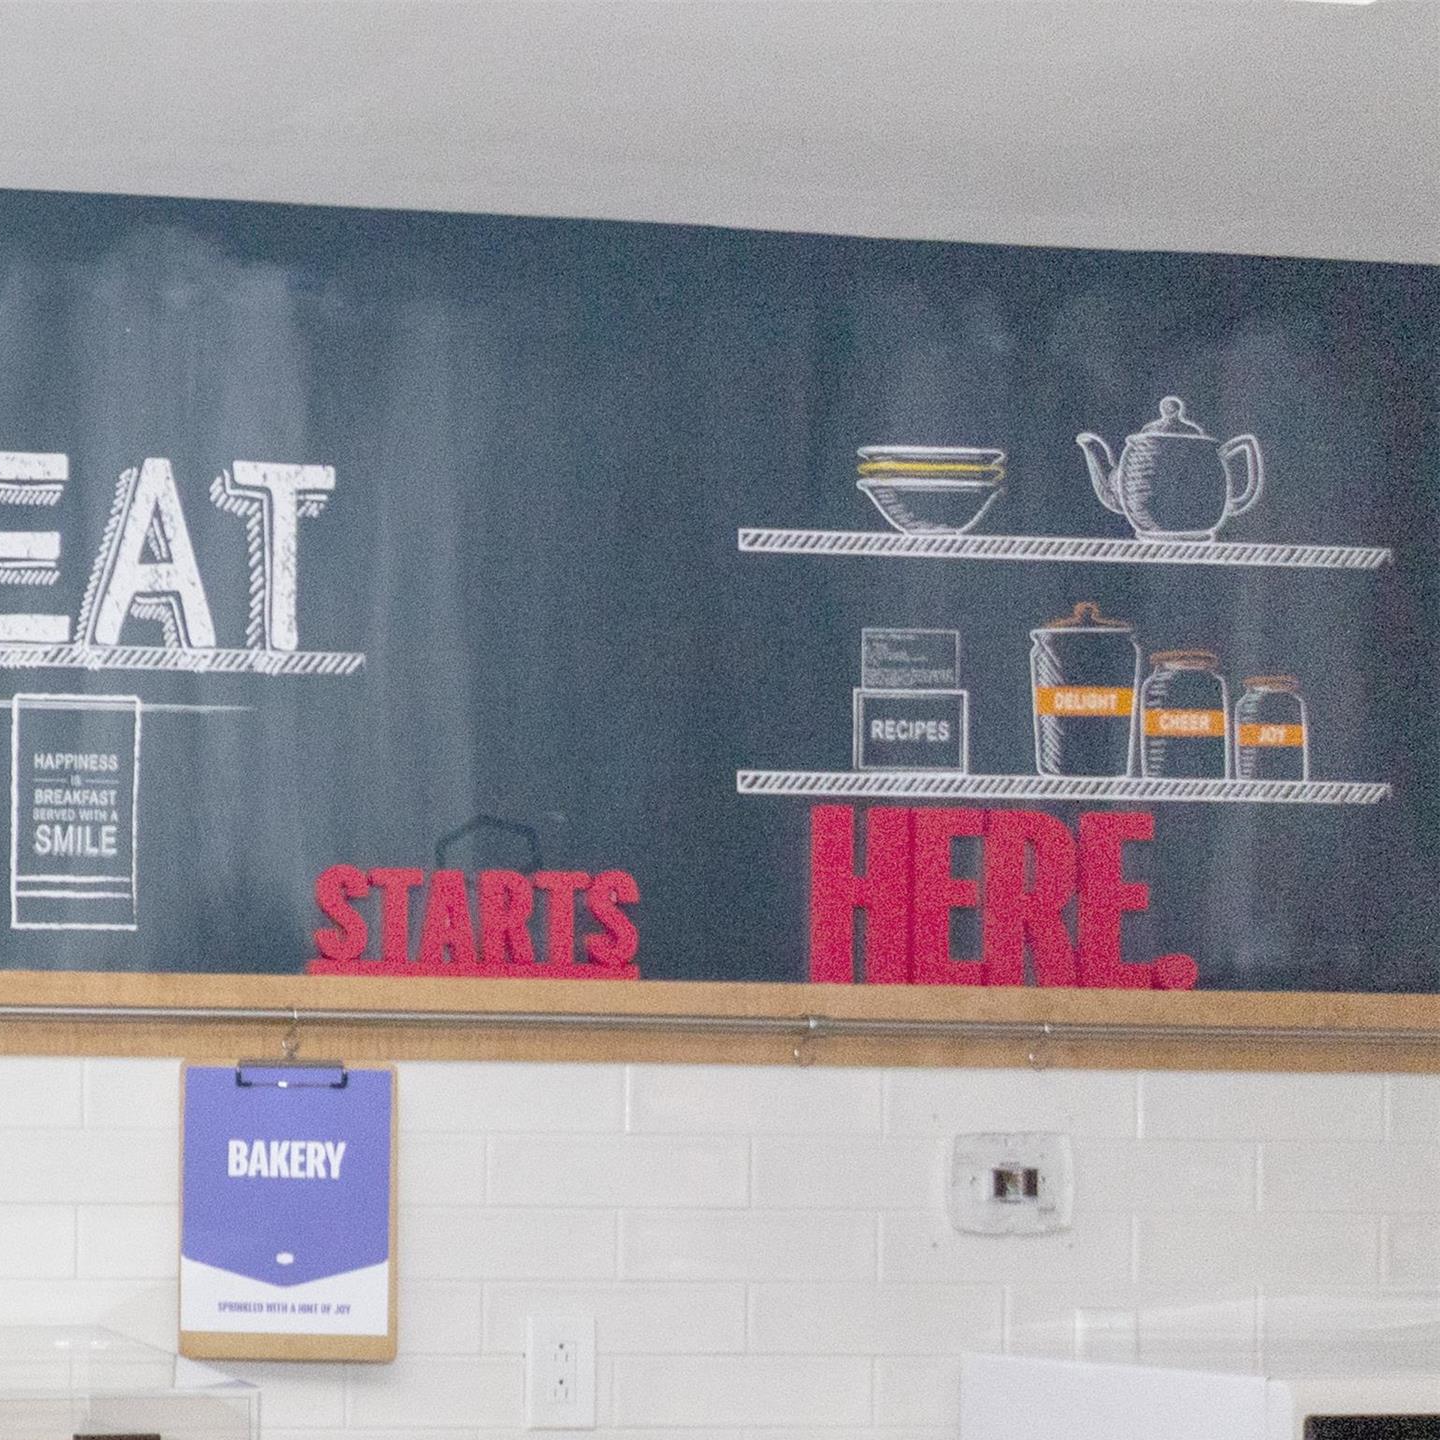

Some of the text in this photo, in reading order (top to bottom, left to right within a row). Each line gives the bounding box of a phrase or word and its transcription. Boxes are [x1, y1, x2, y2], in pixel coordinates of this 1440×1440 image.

[1053, 694, 1118, 711] DELIGHT
[871, 719, 950, 742] RECIPES
[1158, 714, 1211, 732] CHEER
[1258, 726, 1285, 743] JOY
[33, 753, 118, 772] HAPPINESS
[70, 774, 81, 787] IS
[34, 789, 118, 806] BREAKFAST
[32, 807, 119, 822] SERVED WITH A
[35, 824, 118, 856] SMILE
[312, 864, 641, 979] STARTS
[810, 804, 1198, 988] HERE.
[227, 1139, 347, 1180] BAKERY
[218, 1302, 264, 1313] SPRINKLED
[266, 1302, 288, 1314] WITH
[289, 1303, 297, 1314] A
[320, 1303, 332, 1315] OF
[334, 1304, 352, 1315] JOY
